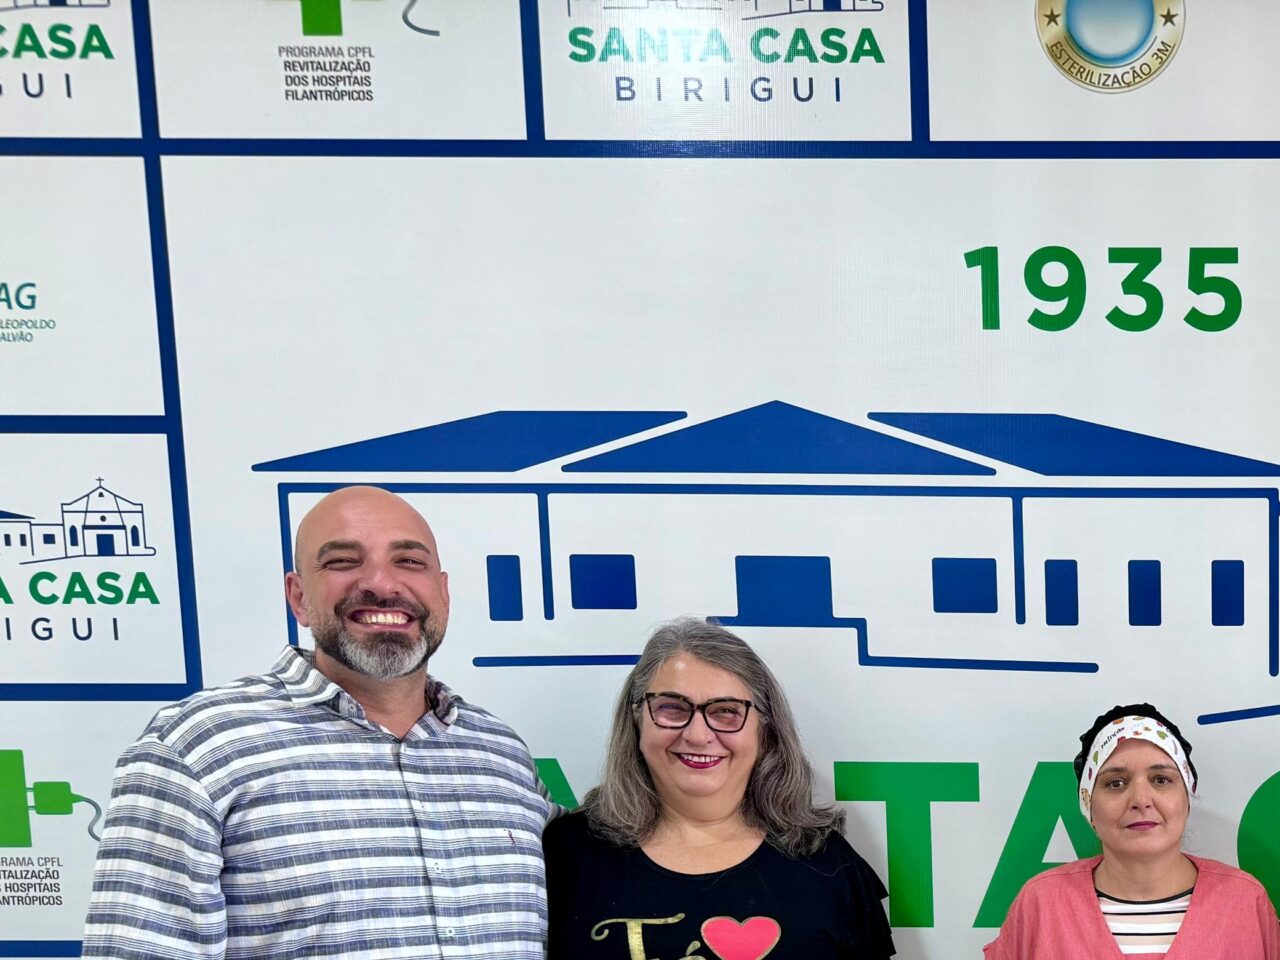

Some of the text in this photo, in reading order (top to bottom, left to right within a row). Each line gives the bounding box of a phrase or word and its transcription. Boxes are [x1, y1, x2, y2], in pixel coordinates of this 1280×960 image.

[278, 46, 375, 58] PROGRAMA CPFL
[568, 27, 885, 63] SANTA CASA
[284, 59, 371, 74] REVITALIZAÇÃO
[1050, 40, 1172, 87] ESTERILIZAÇÃO 3M
[285, 75, 372, 87] DOS HOSPITAIS
[285, 87, 374, 101] FILANTRÓPICOS
[615, 76, 841, 102] BIRIGUI
[963, 245, 1243, 333] 1935
[28, 571, 160, 605] CASA
[37, 857, 63, 867] CPFL
[4, 882, 61, 893] HOSPITAIS
